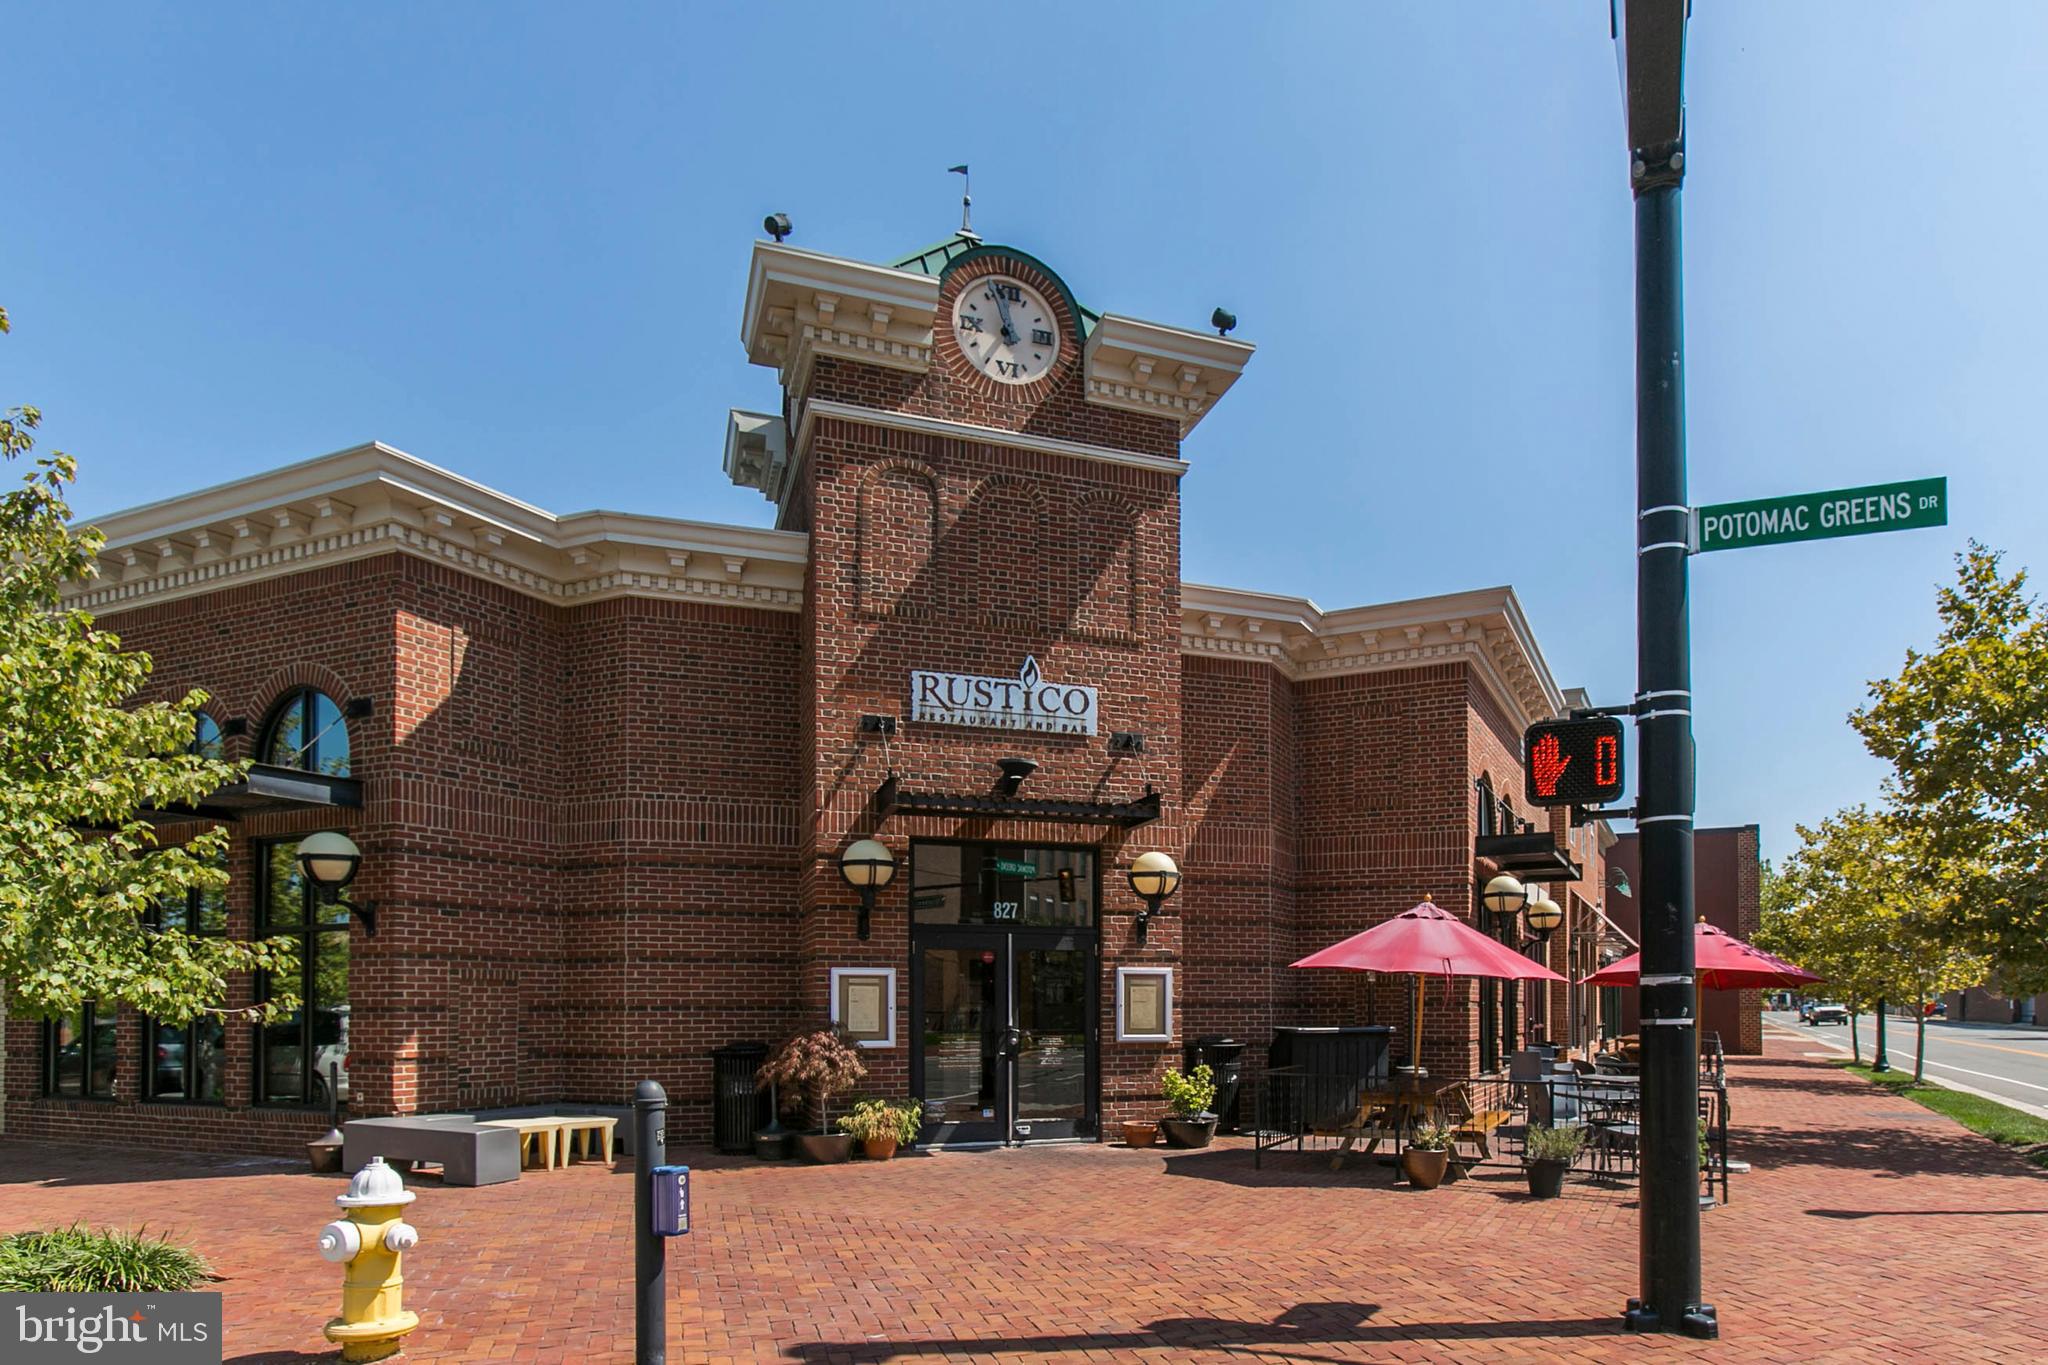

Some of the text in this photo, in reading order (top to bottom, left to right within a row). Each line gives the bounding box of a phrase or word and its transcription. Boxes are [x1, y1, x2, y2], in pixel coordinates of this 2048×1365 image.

[996, 360, 1019, 378] VI
[1704, 492, 1938, 541] POTOMAC GREENS DR
[918, 712, 1088, 734] RESTAURANT AND BAR
[1595, 735, 1617, 786] 0
[993, 901, 1018, 919] 827
